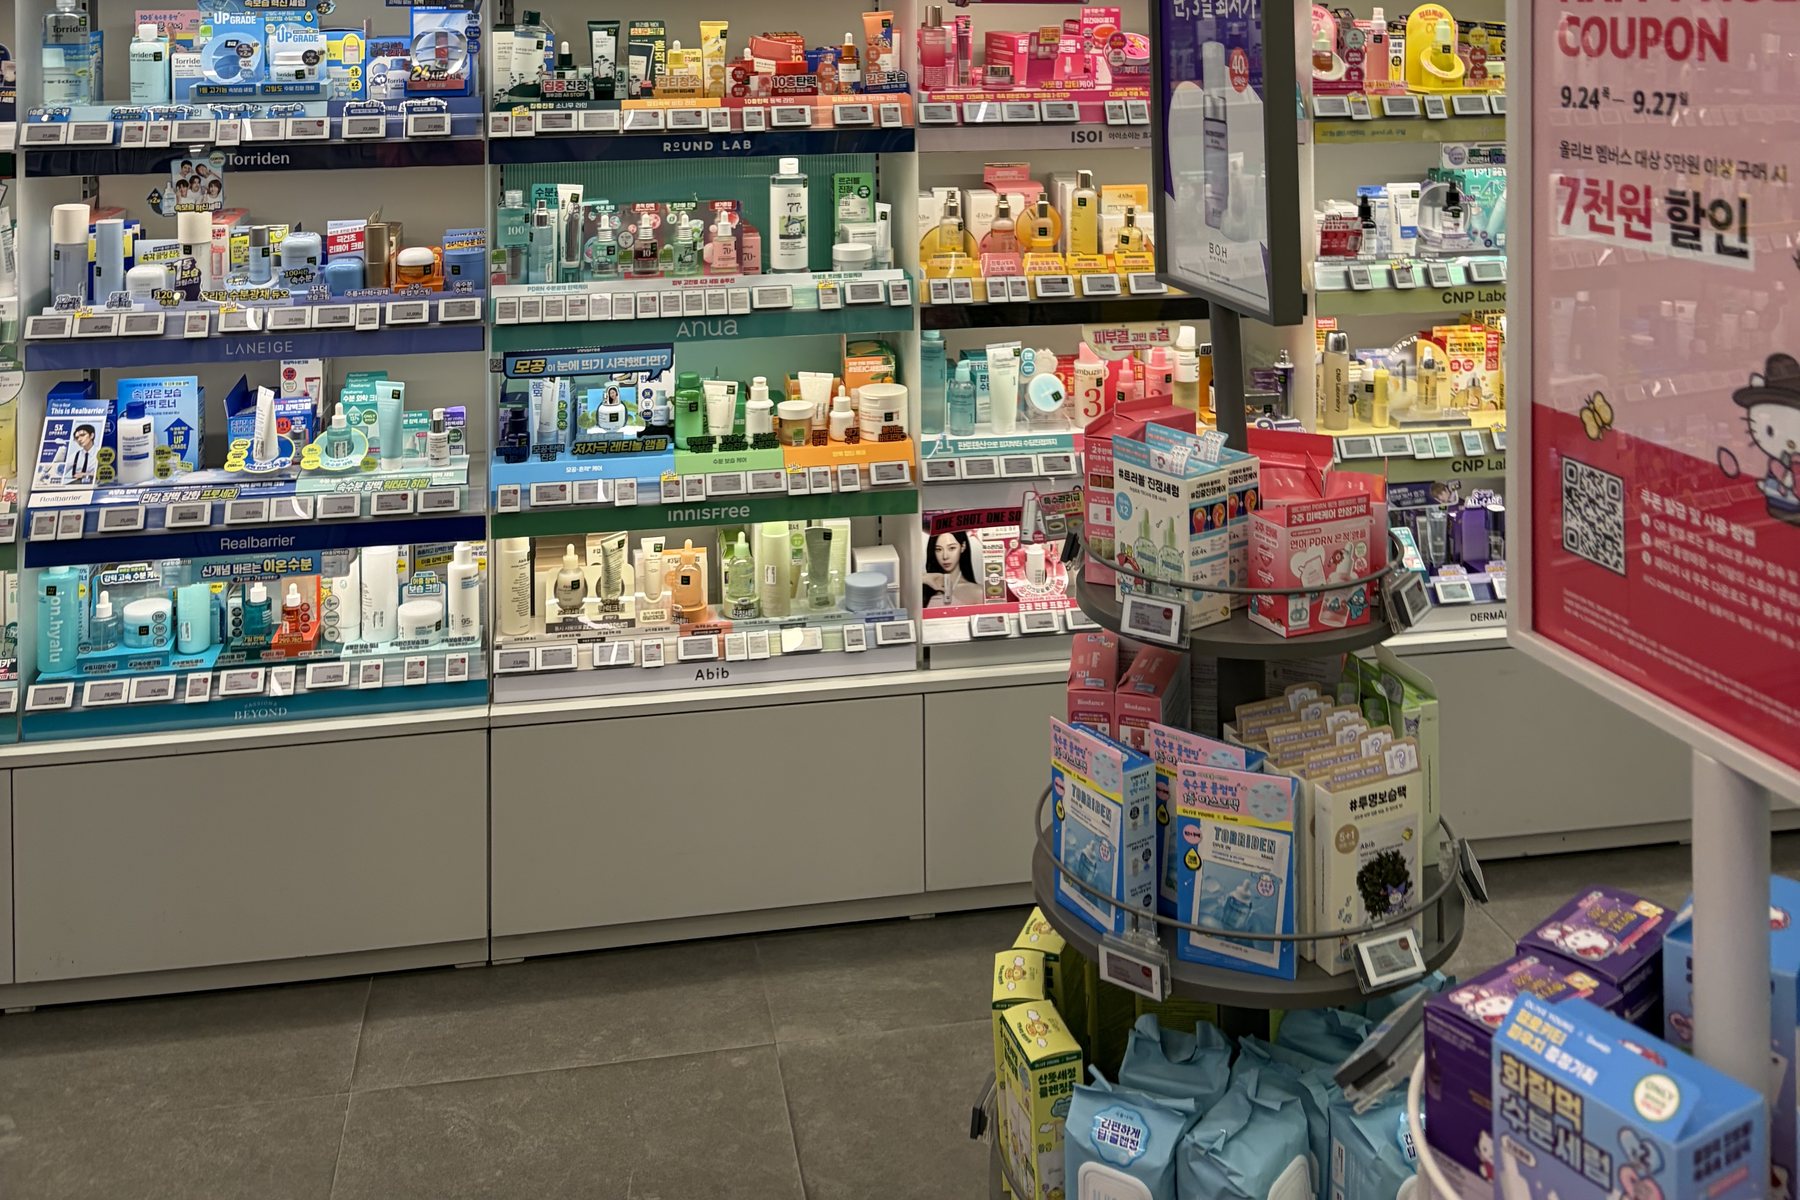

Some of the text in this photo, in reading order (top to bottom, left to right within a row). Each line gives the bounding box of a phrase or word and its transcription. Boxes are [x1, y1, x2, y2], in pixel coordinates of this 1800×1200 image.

[1557, 14, 1729, 63] COUPON
[543, 80, 589, 92] 집중진정
[865, 71, 909, 87] 깊은보습
[722, 140, 752, 150] LAB
[227, 153, 290, 166] Torriden
[1559, 139, 1788, 184] 올리브 멤버스 대상 5만원 이상 구매 시
[1559, 175, 1750, 260] 7천원 할인
[336, 234, 357, 243] 극건조
[329, 244, 349, 253] 리페어
[1208, 241, 1228, 259] BOH
[1442, 291, 1475, 304] CNP
[1094, 329, 1130, 343] 피부결
[226, 341, 293, 354] LANEIGE
[557, 359, 579, 371] 눈에
[581, 358, 604, 371] 띄기
[606, 355, 668, 370] 시작했다면?
[133, 388, 182, 399] 속 깊은 보습
[70, 407, 105, 415] Realbarrier
[159, 399, 177, 409] 토너
[1083, 388, 1101, 418] 3
[1451, 459, 1485, 473] CNP
[1118, 469, 1145, 486] #트러블
[1147, 477, 1180, 498] 진정세럼
[936, 518, 952, 531] ONE
[957, 514, 984, 528] SHOT.
[986, 511, 1006, 524] ONE
[1291, 514, 1304, 524] 2주
[220, 534, 296, 550] Realbarrier
[202, 557, 313, 578] 신개념 바르는 이온수분
[408, 584, 440, 594] 보습 크림
[1469, 609, 1507, 623] DERMA
[695, 667, 730, 681] Abib
[233, 707, 288, 721] BEYOND
[1071, 783, 1112, 822] TORRIDEN
[1199, 794, 1240, 812] 마스크팩
[1349, 785, 1408, 812] #투명보습팩
[1213, 826, 1277, 855] TORRIDEN
[1501, 1050, 1583, 1132] 화잘먹
[1100, 1118, 1142, 1140] 간편하게
[1501, 1091, 1613, 1193] 수분세럼
